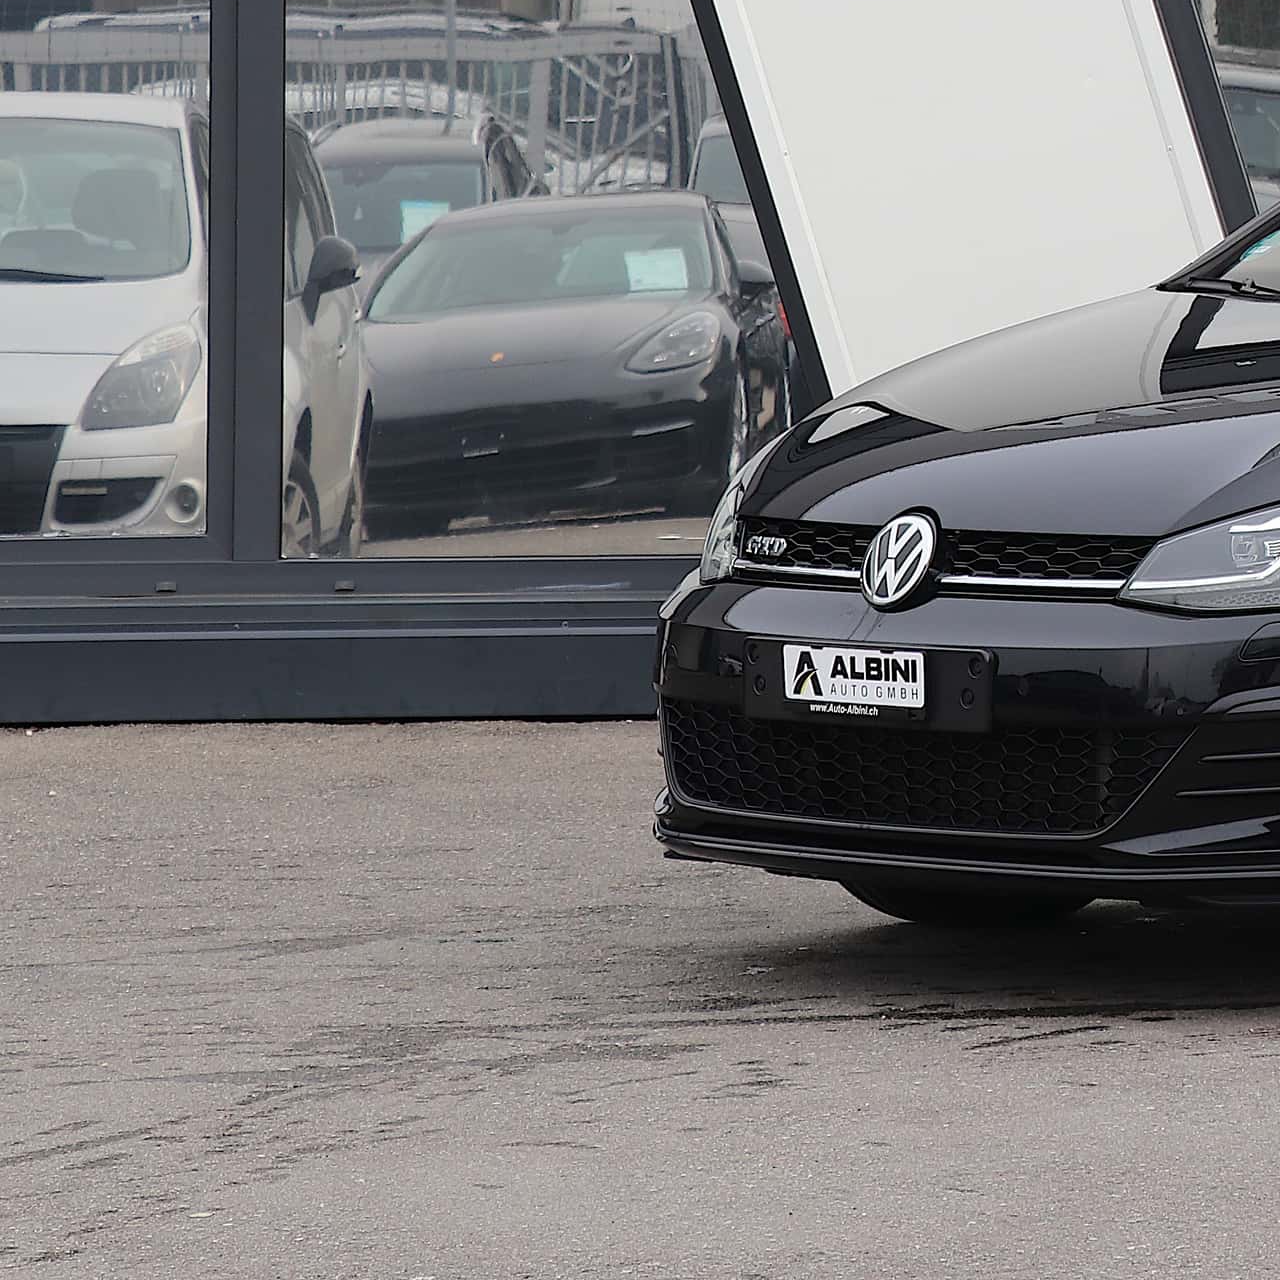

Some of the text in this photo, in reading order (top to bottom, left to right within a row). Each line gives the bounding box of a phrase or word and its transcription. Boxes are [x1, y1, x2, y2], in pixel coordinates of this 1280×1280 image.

[745, 535, 788, 557] GTD
[830, 655, 918, 684] ALBINI
[830, 684, 919, 701] AUTO GMBH
[809, 703, 879, 717] www.Auto-Albini.ch
